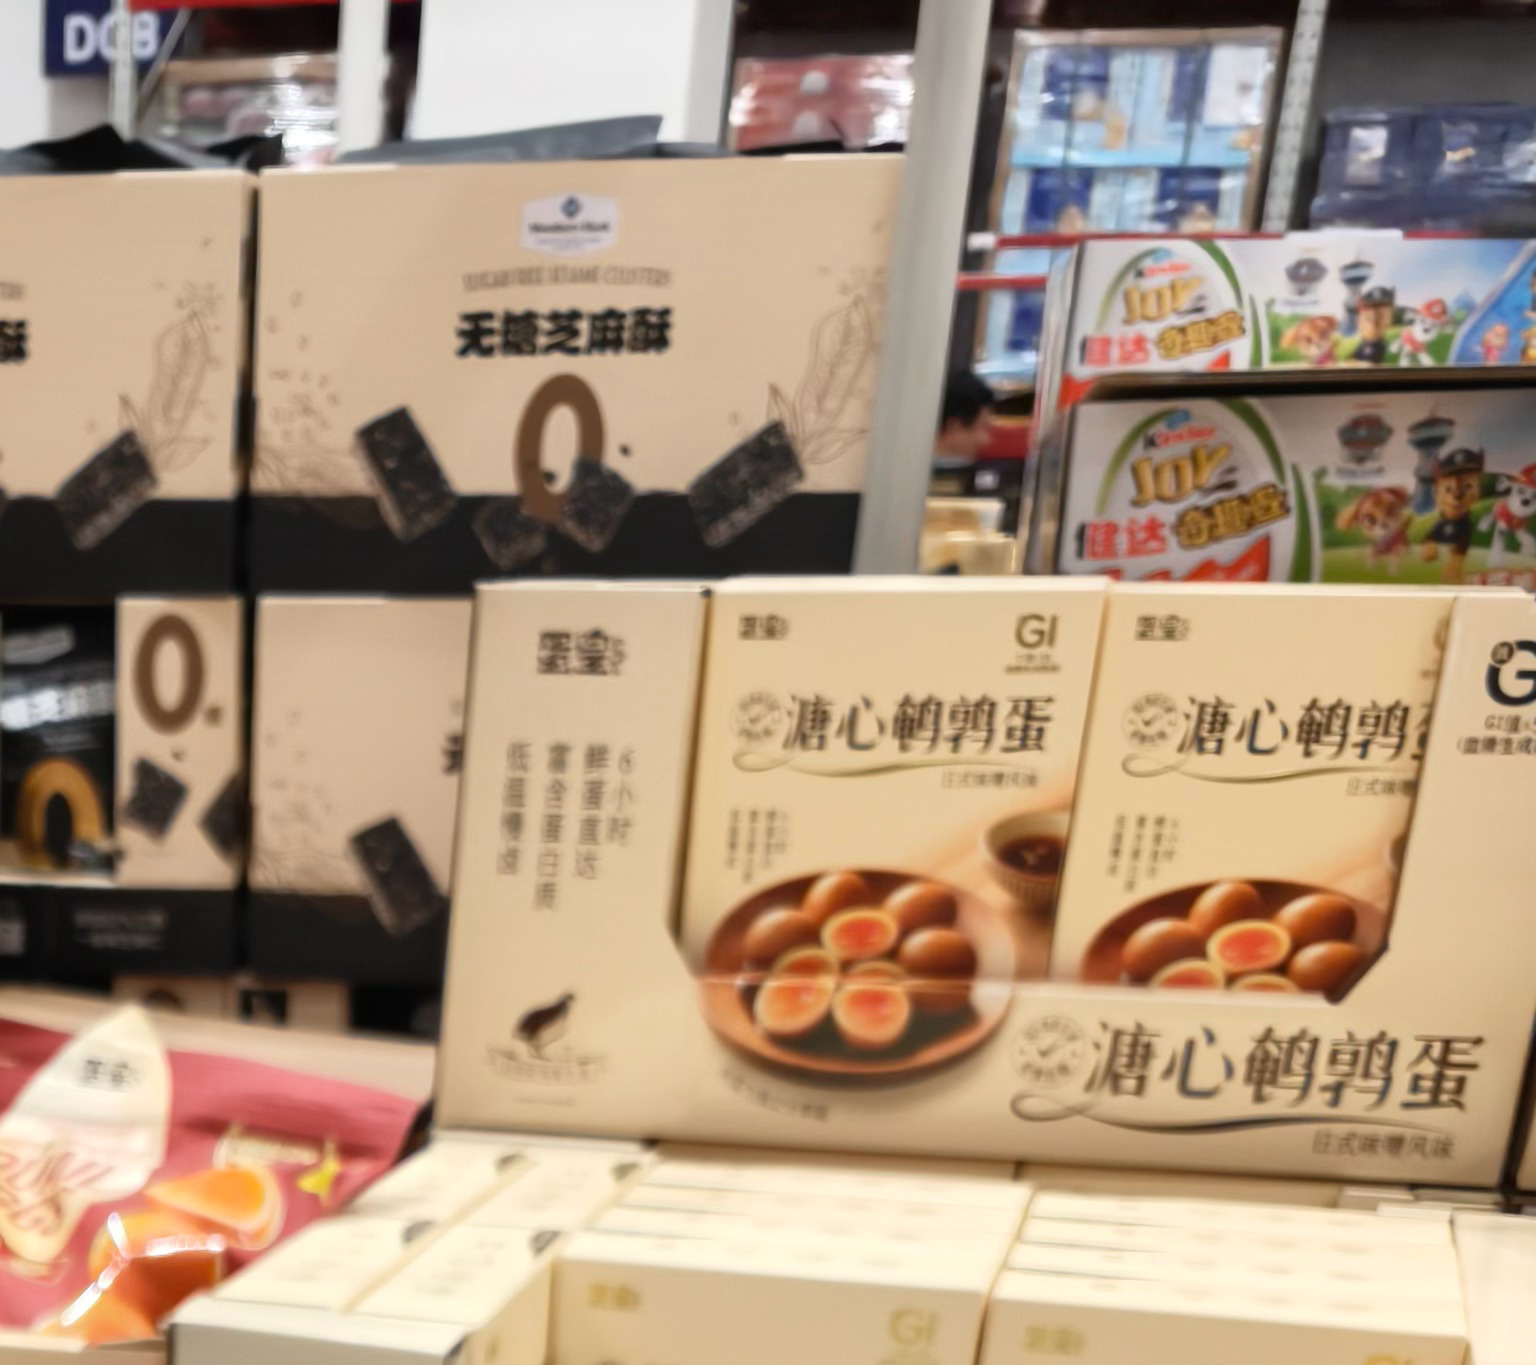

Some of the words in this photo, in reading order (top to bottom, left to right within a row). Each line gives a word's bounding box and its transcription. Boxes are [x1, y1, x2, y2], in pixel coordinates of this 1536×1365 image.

[1014, 612, 1060, 651] GI
[781, 693, 1054, 755] 溏心鹌鹑蛋
[1083, 1020, 1486, 1113] 溏心鹌鹑蛋
